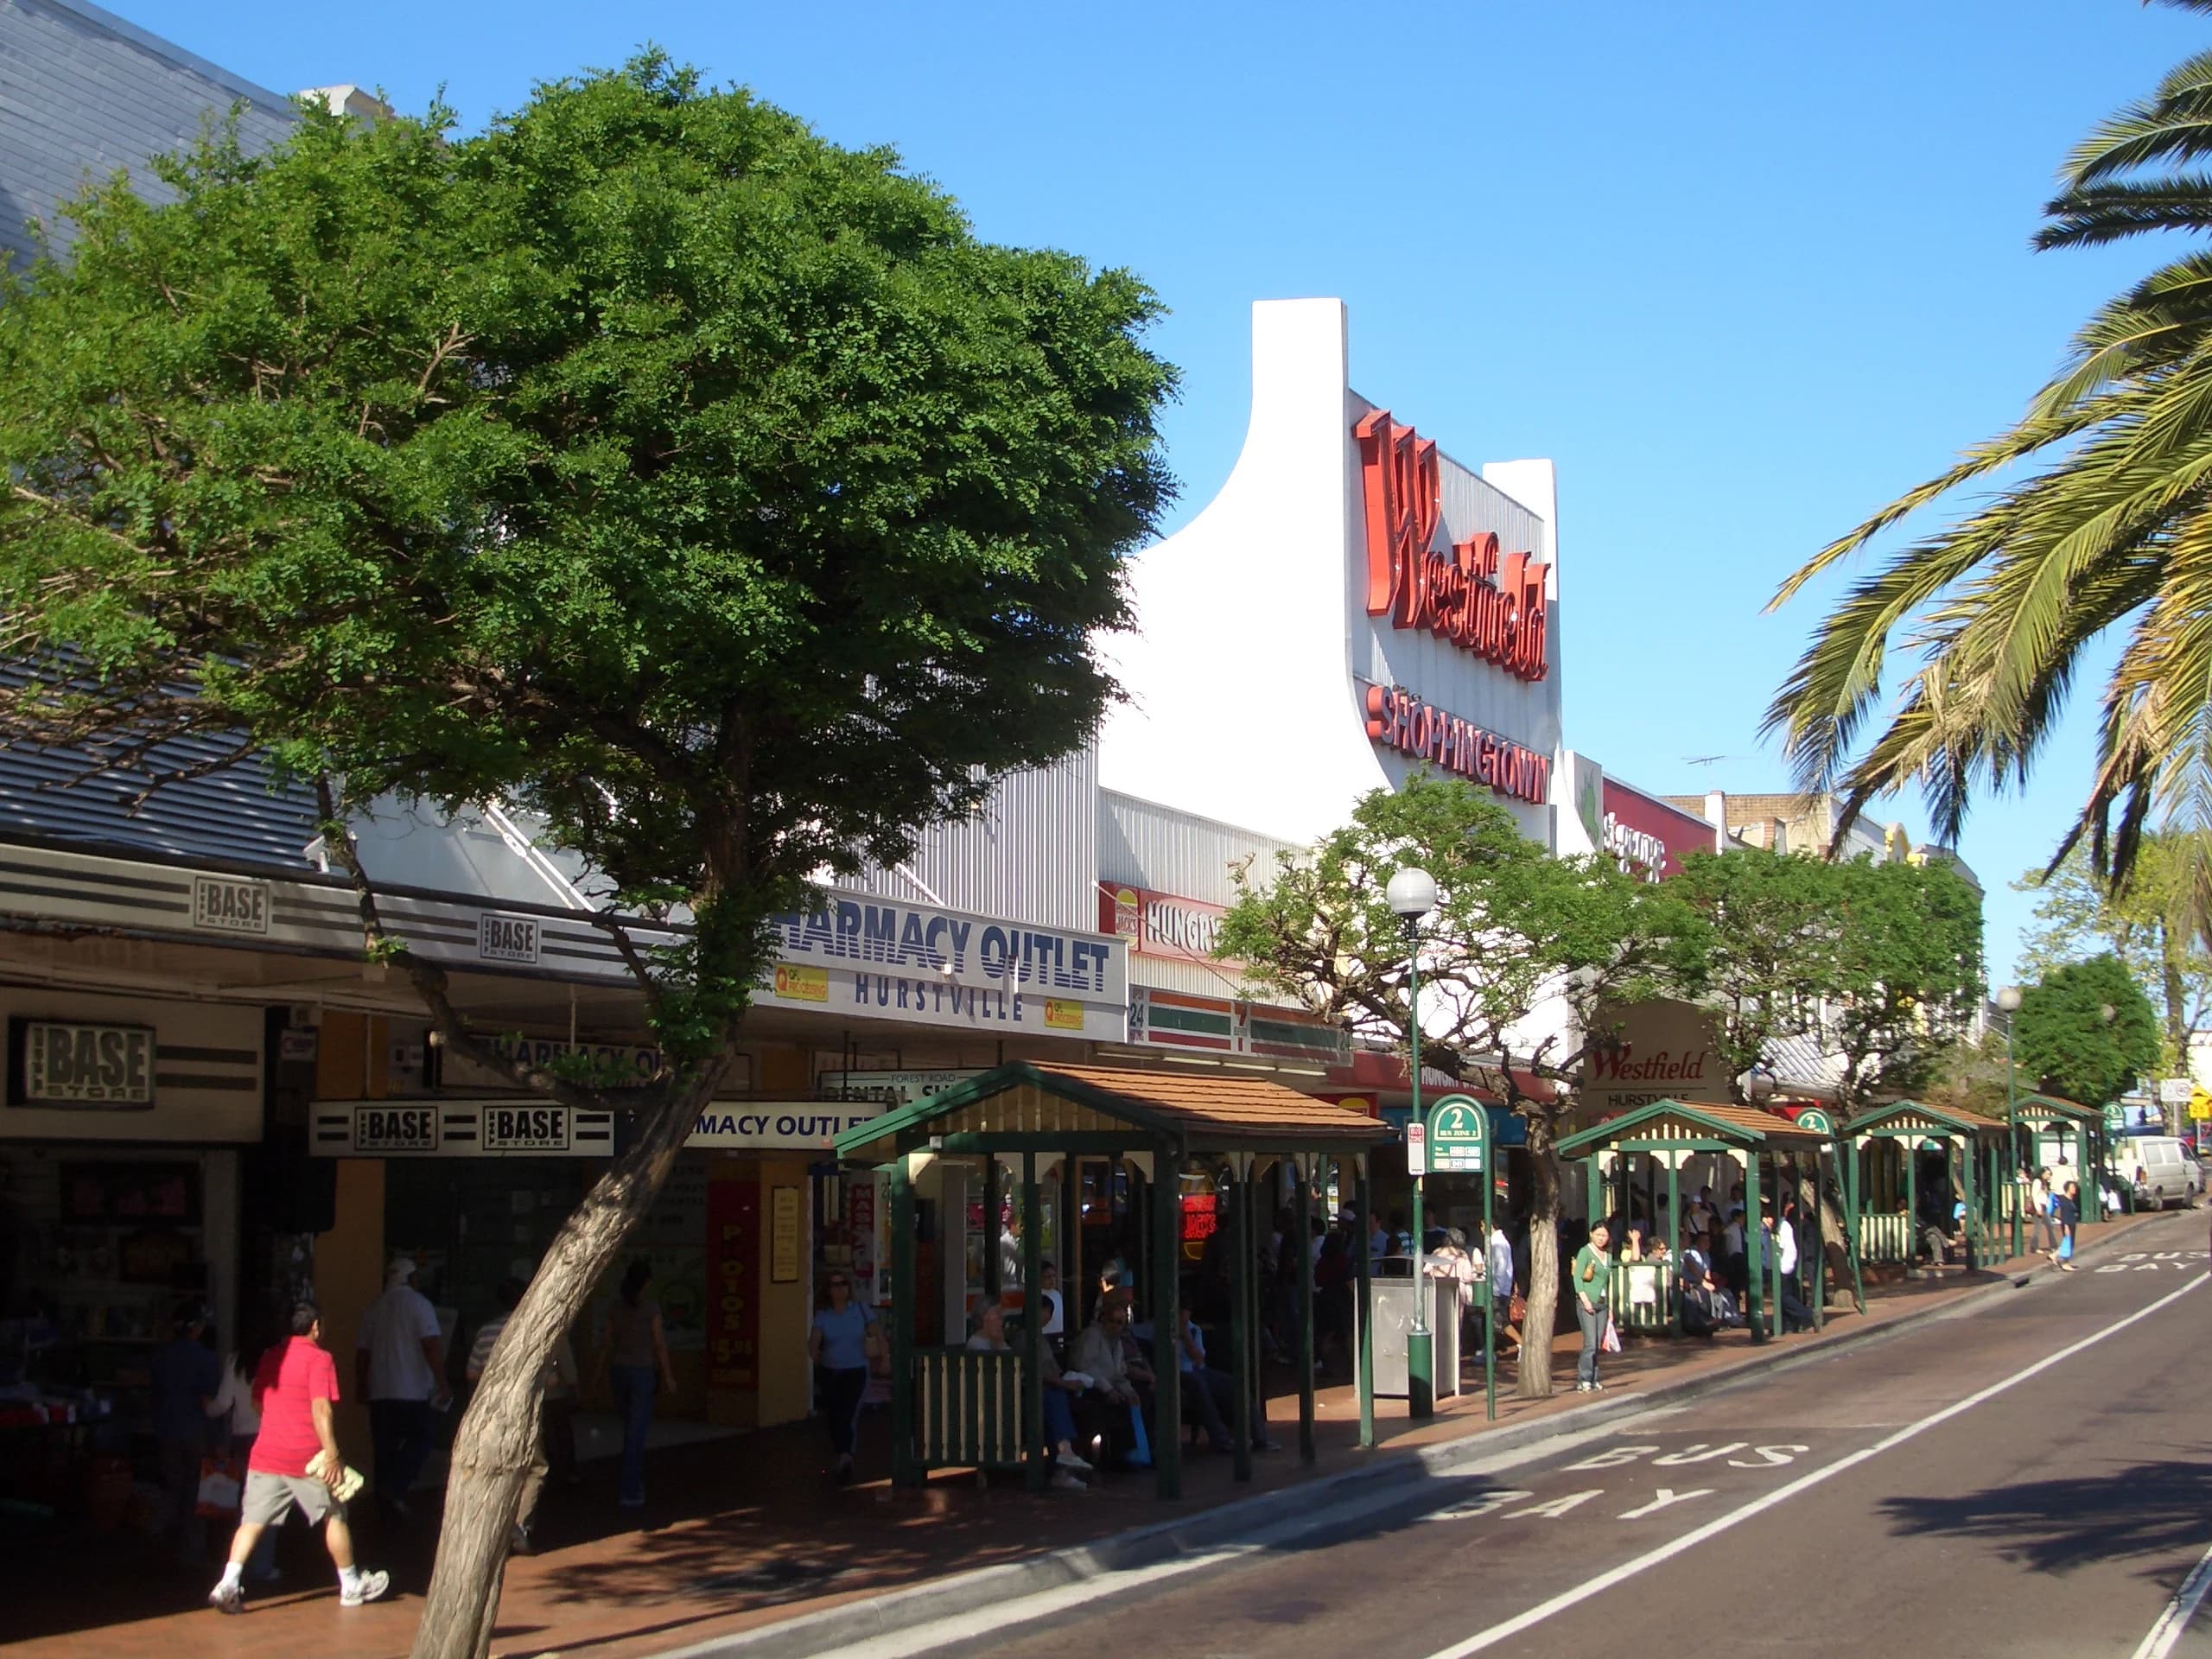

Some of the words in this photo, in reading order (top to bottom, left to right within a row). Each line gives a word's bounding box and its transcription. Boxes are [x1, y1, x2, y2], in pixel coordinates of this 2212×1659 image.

[1356, 409, 1551, 681] Westfield
[1367, 685, 1548, 804] SHOPPINGTOWN
[207, 884, 263, 921] BASE
[207, 917, 262, 929] STORE
[490, 919, 534, 952] BASE
[768, 900, 972, 974] HARMACY
[981, 925, 1109, 993] OUTLET
[855, 974, 1023, 1021] HURSTVILLE
[1130, 1002, 1144, 1027] 24
[48, 1028, 146, 1087] BASE
[1592, 1044, 1709, 1080] Westfield
[47, 1084, 146, 1100] STORE
[891, 1074, 925, 1084] FOREST
[928, 1073, 957, 1082] ROAD
[368, 1111, 431, 1140] BASE
[498, 1110, 563, 1139] BASE
[690, 1115, 771, 1135] MACY
[776, 1115, 874, 1136] OUTLE
[1450, 1108, 1464, 1129] 2
[1807, 1116, 1816, 1129] 2
[2094, 1262, 2196, 1274] BAY
[2116, 1251, 2210, 1262] BUS
[1560, 1442, 1810, 1471] BUS
[1409, 1488, 1718, 1521] BAY
